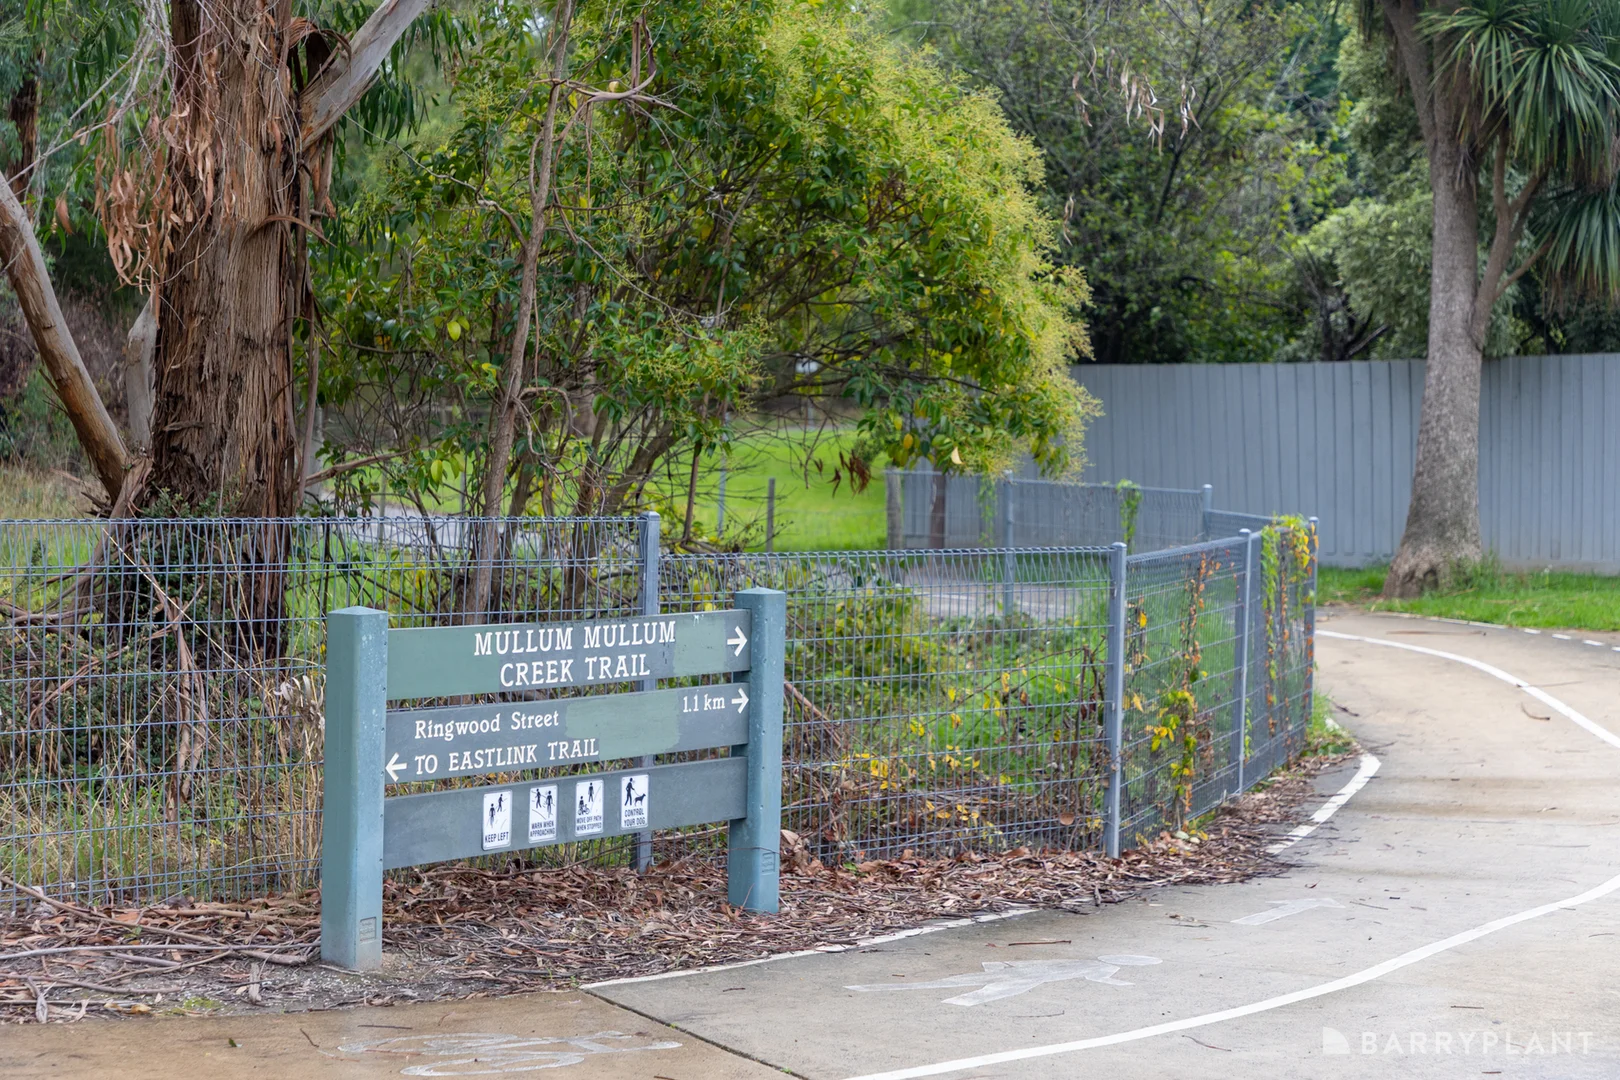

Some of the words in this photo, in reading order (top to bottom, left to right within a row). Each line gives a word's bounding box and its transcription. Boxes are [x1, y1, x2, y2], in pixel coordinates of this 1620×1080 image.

[474, 627, 573, 656] MULLUM
[583, 620, 676, 649] MULLUM
[500, 658, 574, 687] CREEK
[584, 653, 651, 681] TRAIL
[414, 713, 501, 742] Ringwood
[511, 710, 559, 731] Street
[682, 694, 700, 713] 1.1
[703, 693, 726, 711] km
[414, 754, 438, 775] TO
[448, 744, 538, 772] EASTLINK
[547, 738, 599, 761] TRAIL
[624, 807, 645, 817] CONTROL
[531, 822, 543, 830] WARN
[543, 820, 554, 828] WHEN
[624, 818, 636, 827] YOUR
[636, 816, 646, 825] DOG
[484, 833, 497, 843] KEEP
[497, 831, 509, 841] LEFT
[530, 827, 556, 837] APPROACHING
